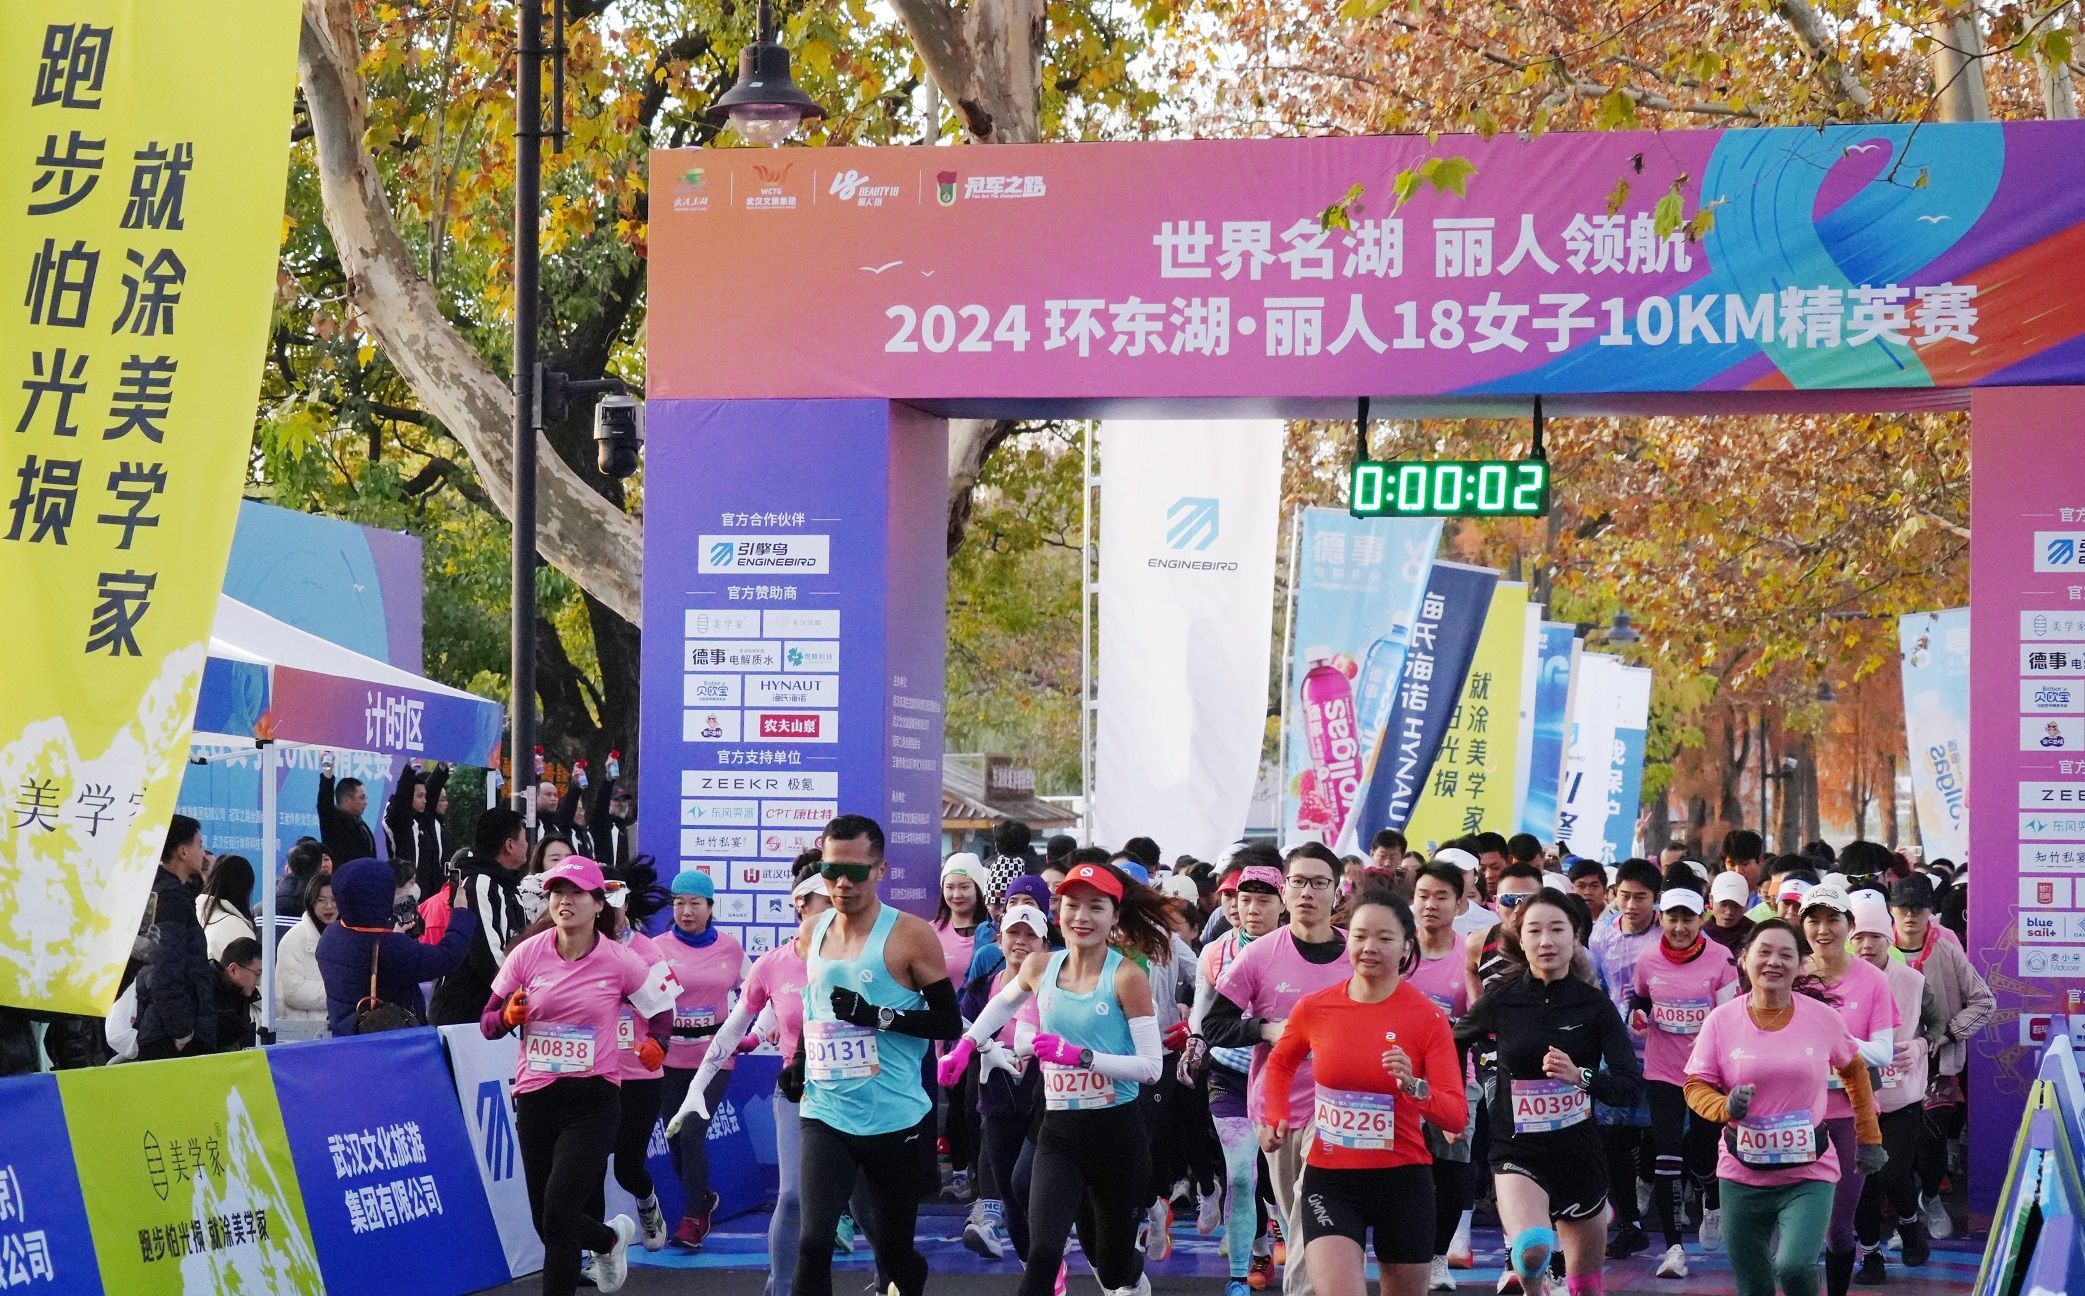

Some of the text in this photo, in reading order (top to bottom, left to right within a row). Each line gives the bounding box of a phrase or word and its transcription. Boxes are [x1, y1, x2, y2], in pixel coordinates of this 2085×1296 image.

[964, 176, 1046, 199] 冠军之路
[1153, 212, 1693, 280] 世界名湖 丽人领航
[3, 22, 113, 546] 跑步怕光损
[884, 304, 1031, 353] 2024
[85, 141, 194, 657] 就涂美学家
[1354, 466, 1543, 510] 0:00:02
[721, 512, 805, 527] 官方合作伙伴
[738, 542, 788, 556] 引擎鸟
[737, 558, 816, 567] ENGINEBIRD
[1148, 558, 1238, 571] ENGINEBIRD
[727, 585, 797, 600] 官方赞助商
[692, 648, 774, 666] 德事 电解质水
[2029, 652, 2067, 670] 德事
[761, 680, 822, 691] HYNAUT
[365, 690, 424, 751] 计时区
[764, 719, 816, 733] 农夫山泉
[717, 750, 801, 764] 官方支持单位
[1462, 672, 1492, 834] 就涂美学家
[702, 777, 814, 791] ZEEKR 极氪
[711, 807, 754, 818] 东风奕派
[766, 808, 832, 820] CPT 康比特
[2026, 917, 2053, 927] blue
[1655, 1007, 1705, 1023] A0850
[529, 1038, 588, 1060] A0838
[808, 1039, 866, 1061] B0131
[1517, 1089, 1585, 1116] A0390
[1317, 1104, 1387, 1132] A0226
[1740, 1129, 1808, 1149] A0193
[169, 1136, 225, 1184] 美学家
[327, 1120, 427, 1180] 武汉文化旅游
[345, 1174, 443, 1235] 集团有限公司
[138, 1208, 271, 1264] 跑步怕光损 就涂美学家
